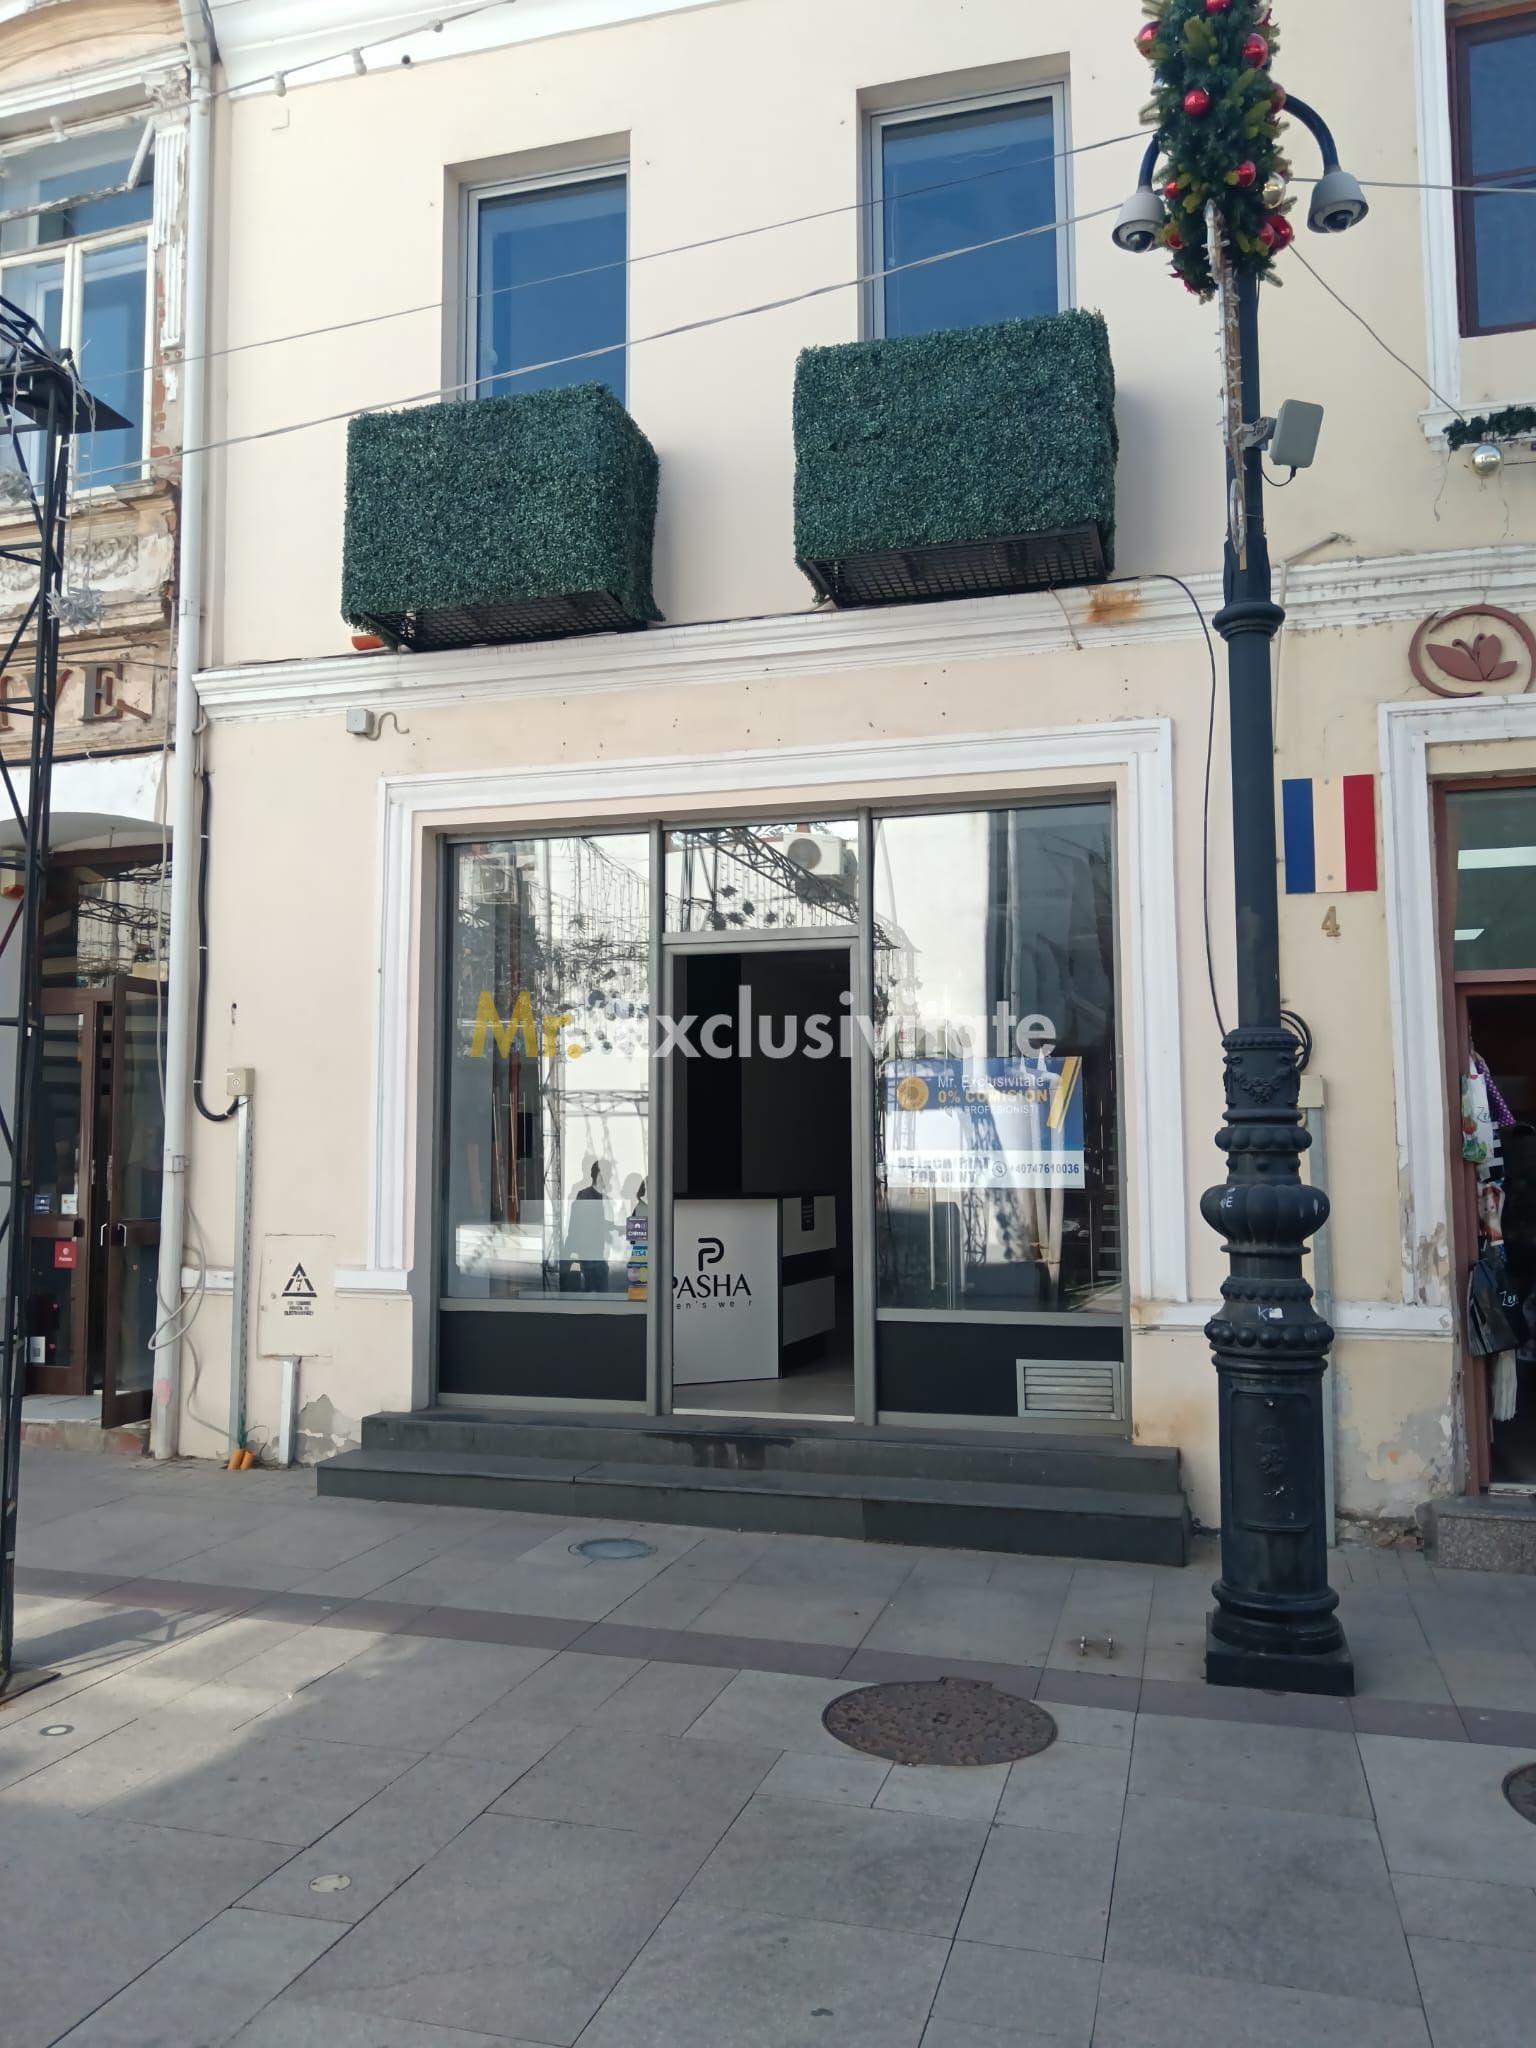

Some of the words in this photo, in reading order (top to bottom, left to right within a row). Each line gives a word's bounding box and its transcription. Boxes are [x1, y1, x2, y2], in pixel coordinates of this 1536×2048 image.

[1321, 906, 1341, 937] 4
[938, 1075, 957, 1088] Mr.
[961, 1075, 1044, 1089] Exclusivitate
[938, 1089, 960, 1104] 0%
[718, 1299, 753, 1309] wer
